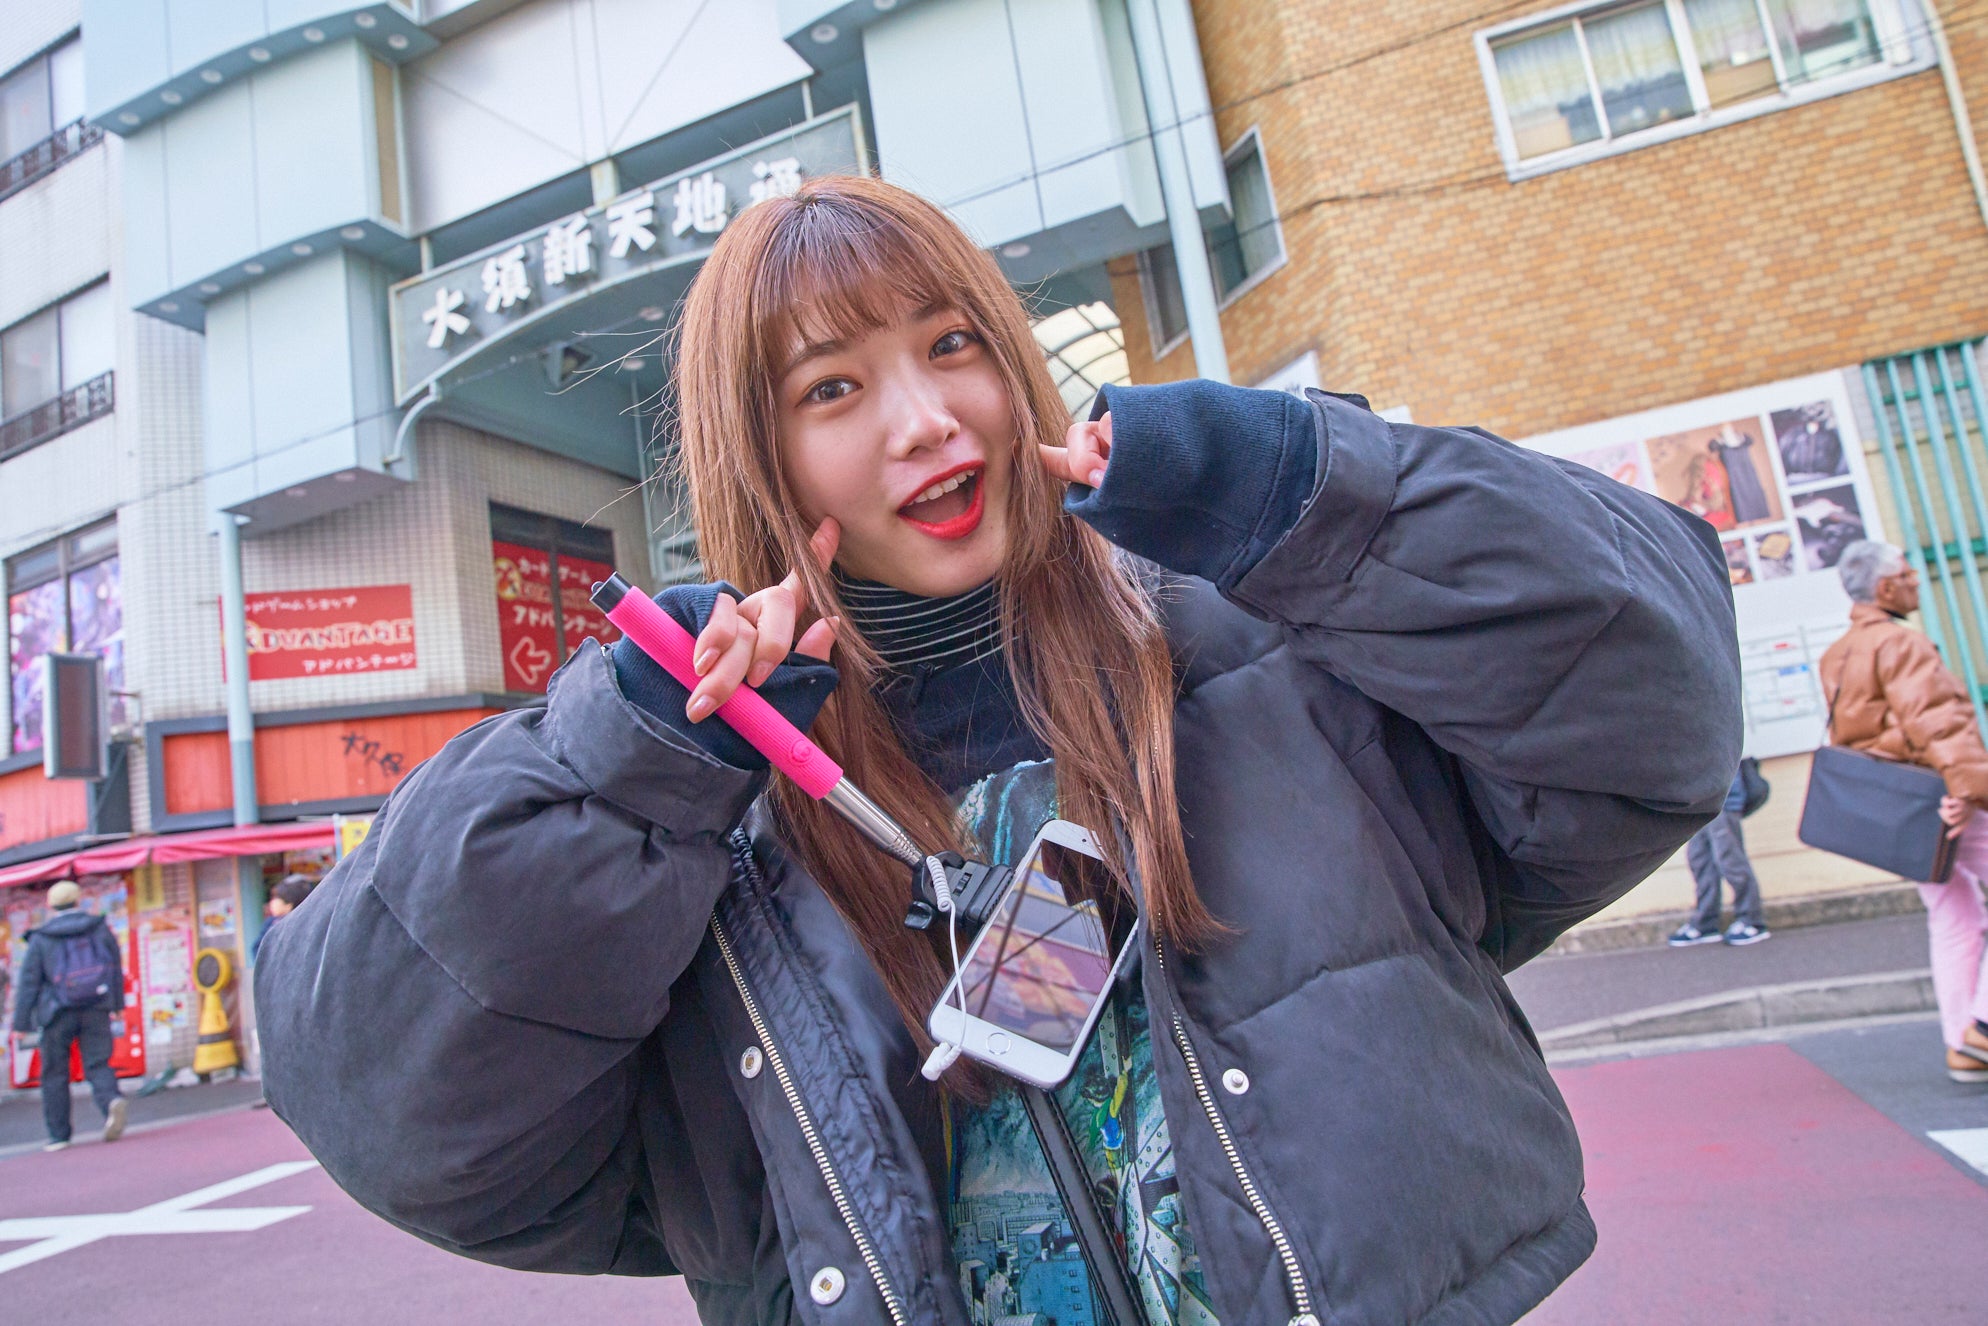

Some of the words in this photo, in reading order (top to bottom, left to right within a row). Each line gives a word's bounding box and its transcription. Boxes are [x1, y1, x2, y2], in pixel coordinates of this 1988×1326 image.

[303, 652, 416, 675] アドバンテージ
